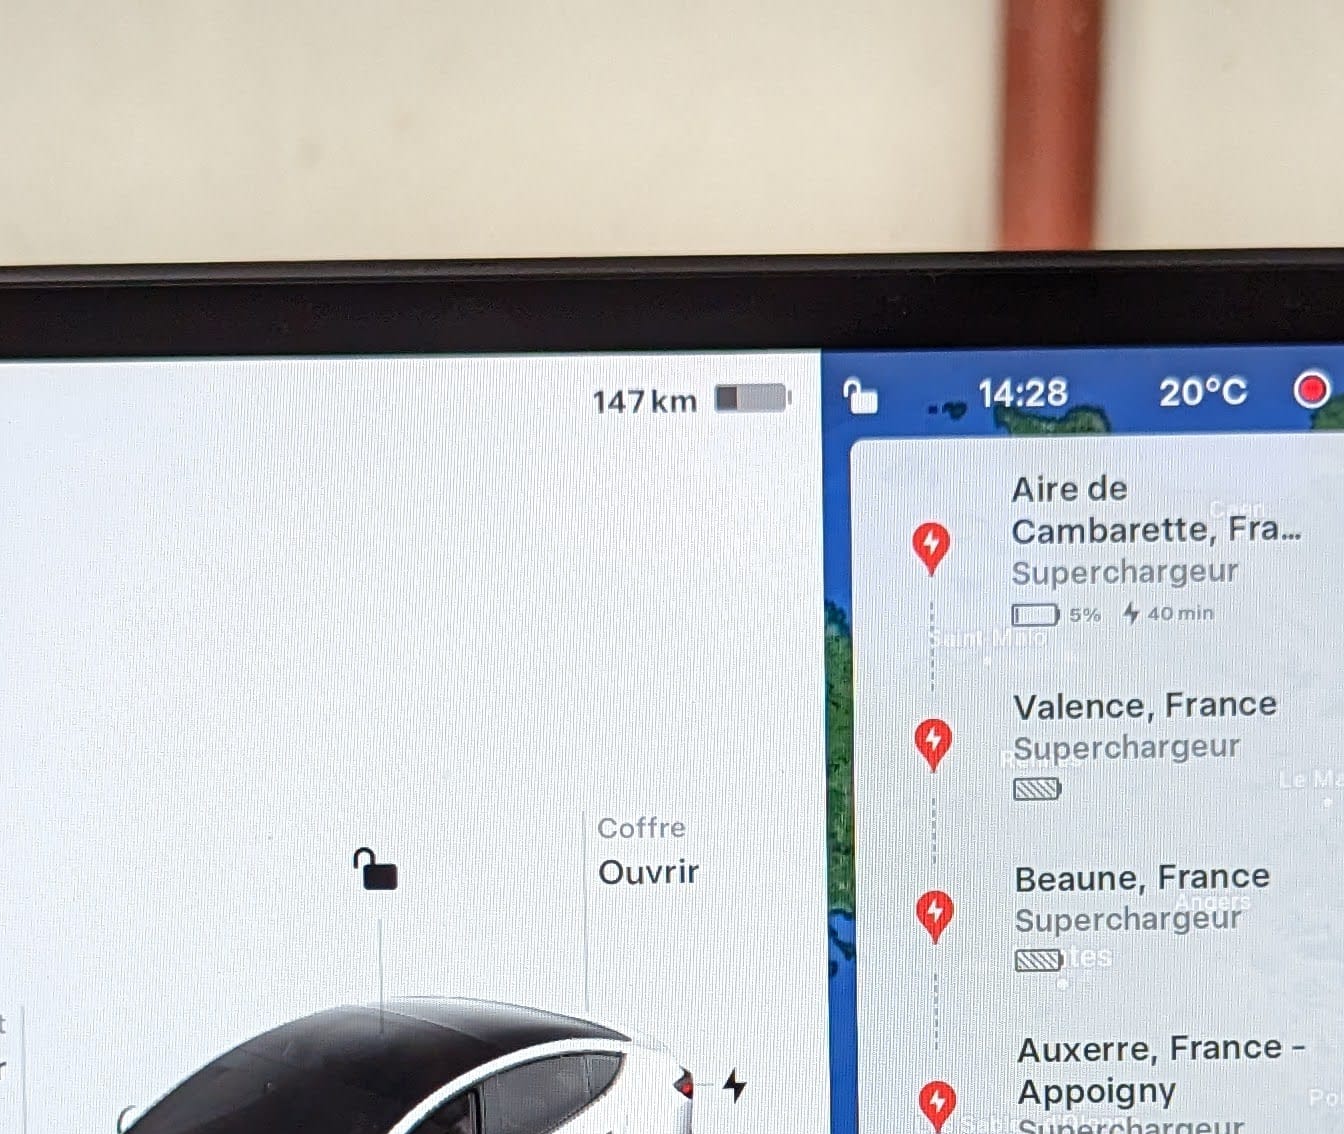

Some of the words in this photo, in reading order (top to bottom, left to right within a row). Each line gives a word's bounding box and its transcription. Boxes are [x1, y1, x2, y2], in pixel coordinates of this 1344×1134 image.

[592, 389, 644, 414] 147
[652, 388, 698, 414] km
[978, 379, 1069, 408] 14:28
[1159, 378, 1248, 407] 20°C
[1012, 475, 1079, 503] Aire
[1087, 474, 1129, 502] de
[1012, 515, 1217, 548] Cambarette,
[1012, 557, 1240, 590] Superchargeur
[1068, 607, 1102, 622] 5%
[1147, 606, 1173, 621] 40
[1177, 604, 1215, 621] min
[1013, 692, 1155, 724] Valence,
[1165, 691, 1278, 719] France
[1014, 733, 1242, 764] Superchargeur
[597, 816, 686, 840] Coffre
[598, 857, 700, 886] Ouvrir
[1015, 866, 1146, 896] Beaune,
[1158, 863, 1271, 890] France
[1015, 905, 1242, 938] Superchargeur
[1017, 1035, 1159, 1066] Auxerre,
[1170, 1033, 1283, 1062] France
[1018, 1077, 1177, 1110] Appoigny
